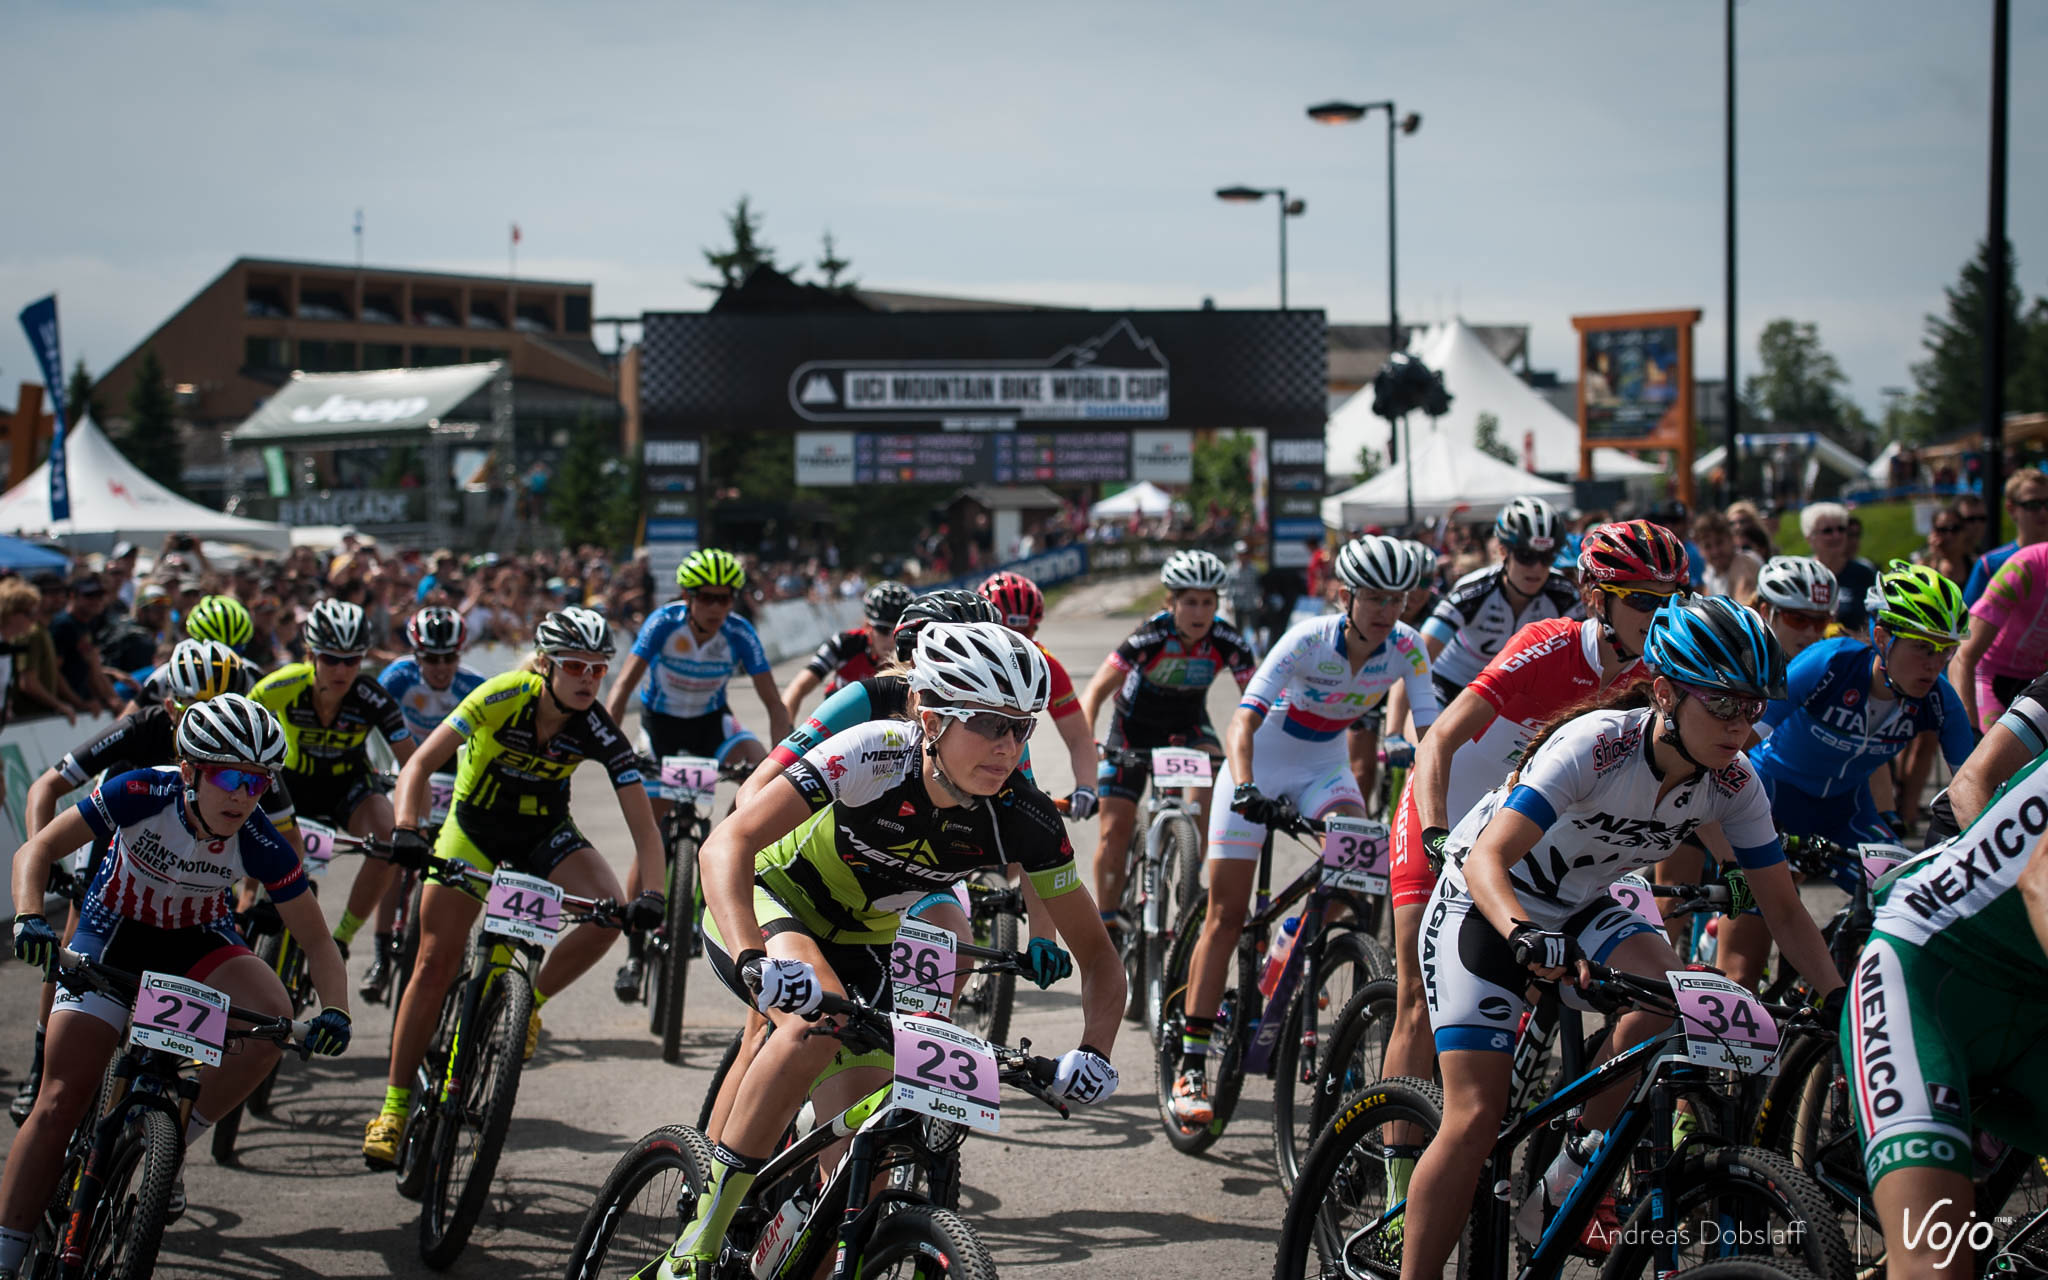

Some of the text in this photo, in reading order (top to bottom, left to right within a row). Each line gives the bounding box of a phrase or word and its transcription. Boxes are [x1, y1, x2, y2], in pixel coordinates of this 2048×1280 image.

[853, 376, 1169, 400] UCI MOUNTAIN BIKE WORLD CUP
[291, 395, 428, 422] Jeep
[1821, 705, 1915, 737] ITALIA
[91, 728, 125, 757] MAXXIS
[673, 768, 704, 787] 41
[1166, 758, 1199, 775] 55
[143, 828, 162, 842] TEAM
[877, 817, 905, 834] WELEDA
[131, 844, 170, 874] NINER
[136, 836, 232, 880] STAN'S NOTUBES
[1337, 836, 1377, 869] 39
[502, 891, 546, 922] 44
[508, 924, 535, 938] Jeep
[892, 941, 940, 985] 36
[1423, 901, 1448, 1013] GIANT
[153, 995, 211, 1033] 27
[894, 992, 924, 1010] Jeep
[1698, 995, 1761, 1038] 34
[161, 1037, 195, 1055] Jeep
[1861, 952, 1904, 1119] MEXICO
[916, 1040, 979, 1091] 23
[1719, 1049, 1753, 1068] Jeep
[928, 1097, 967, 1120] Jeep
[1334, 1093, 1388, 1135] MAXXIS
[1868, 1138, 1956, 1181] EXICO
